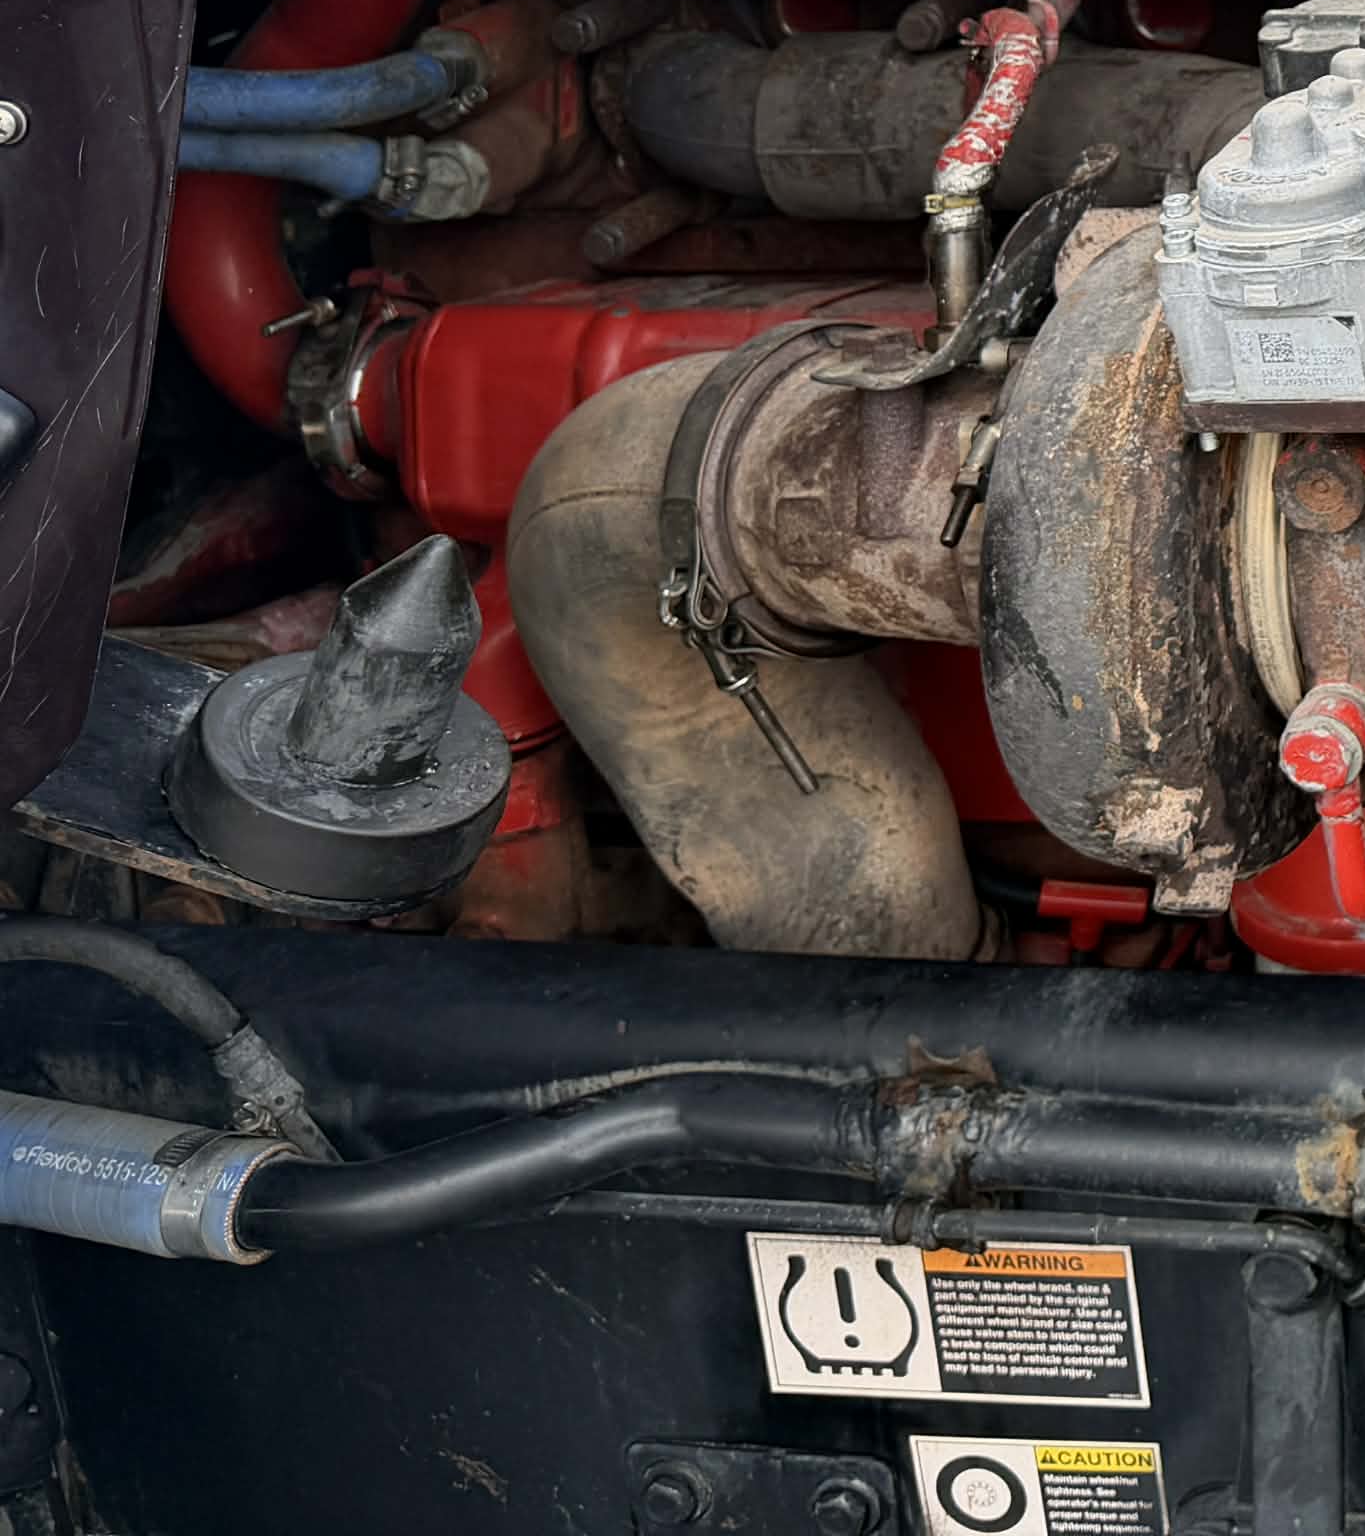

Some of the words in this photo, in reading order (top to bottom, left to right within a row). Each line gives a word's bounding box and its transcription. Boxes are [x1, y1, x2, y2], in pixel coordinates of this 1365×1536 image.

[24, 1144, 92, 1175] Flexfab
[93, 1159, 168, 1186] 5515-125
[984, 1252, 1085, 1271] WARNING
[932, 1277, 954, 1289] Use
[956, 1279, 980, 1291] only
[983, 1280, 1002, 1291] the
[1003, 1281, 1036, 1292] wheel
[1076, 1283, 1100, 1294] size
[933, 1291, 957, 1302] part
[979, 1293, 1027, 1303] installed
[1028, 1294, 1043, 1306] by
[1044, 1294, 1064, 1304] the
[1065, 1295, 1109, 1307] original
[935, 1304, 994, 1315] equipment
[1075, 1307, 1098, 1318] Use
[1100, 1308, 1112, 1319] of
[937, 1315, 985, 1325] different
[986, 1317, 1019, 1327] wheel
[1020, 1318, 1054, 1328] brand
[1055, 1320, 1069, 1329] or
[1070, 1320, 1094, 1330] size
[1095, 1321, 1128, 1331] could
[938, 1328, 973, 1337] cause
[974, 1329, 1004, 1338] valve
[1006, 1330, 1035, 1340] stem
[1036, 1330, 1048, 1341] to
[1050, 1331, 1097, 1342] interfere
[1099, 1332, 1124, 1343] with
[950, 1339, 982, 1350] brake
[983, 1341, 1047, 1353] component
[1048, 1343, 1082, 1353] which
[1083, 1344, 1116, 1355] could
[942, 1350, 967, 1361] lead
[968, 1351, 981, 1361] to
[982, 1351, 1007, 1362] loss
[1008, 1352, 1020, 1363] of
[1022, 1353, 1062, 1365] vehicle
[1063, 1355, 1104, 1366] control
[1105, 1356, 1128, 1368] and
[944, 1364, 969, 1376] may
[970, 1363, 995, 1375] lead
[995, 1365, 1009, 1375] to
[1009, 1366, 1059, 1378] personal
[1058, 1450, 1153, 1467] CAUTION
